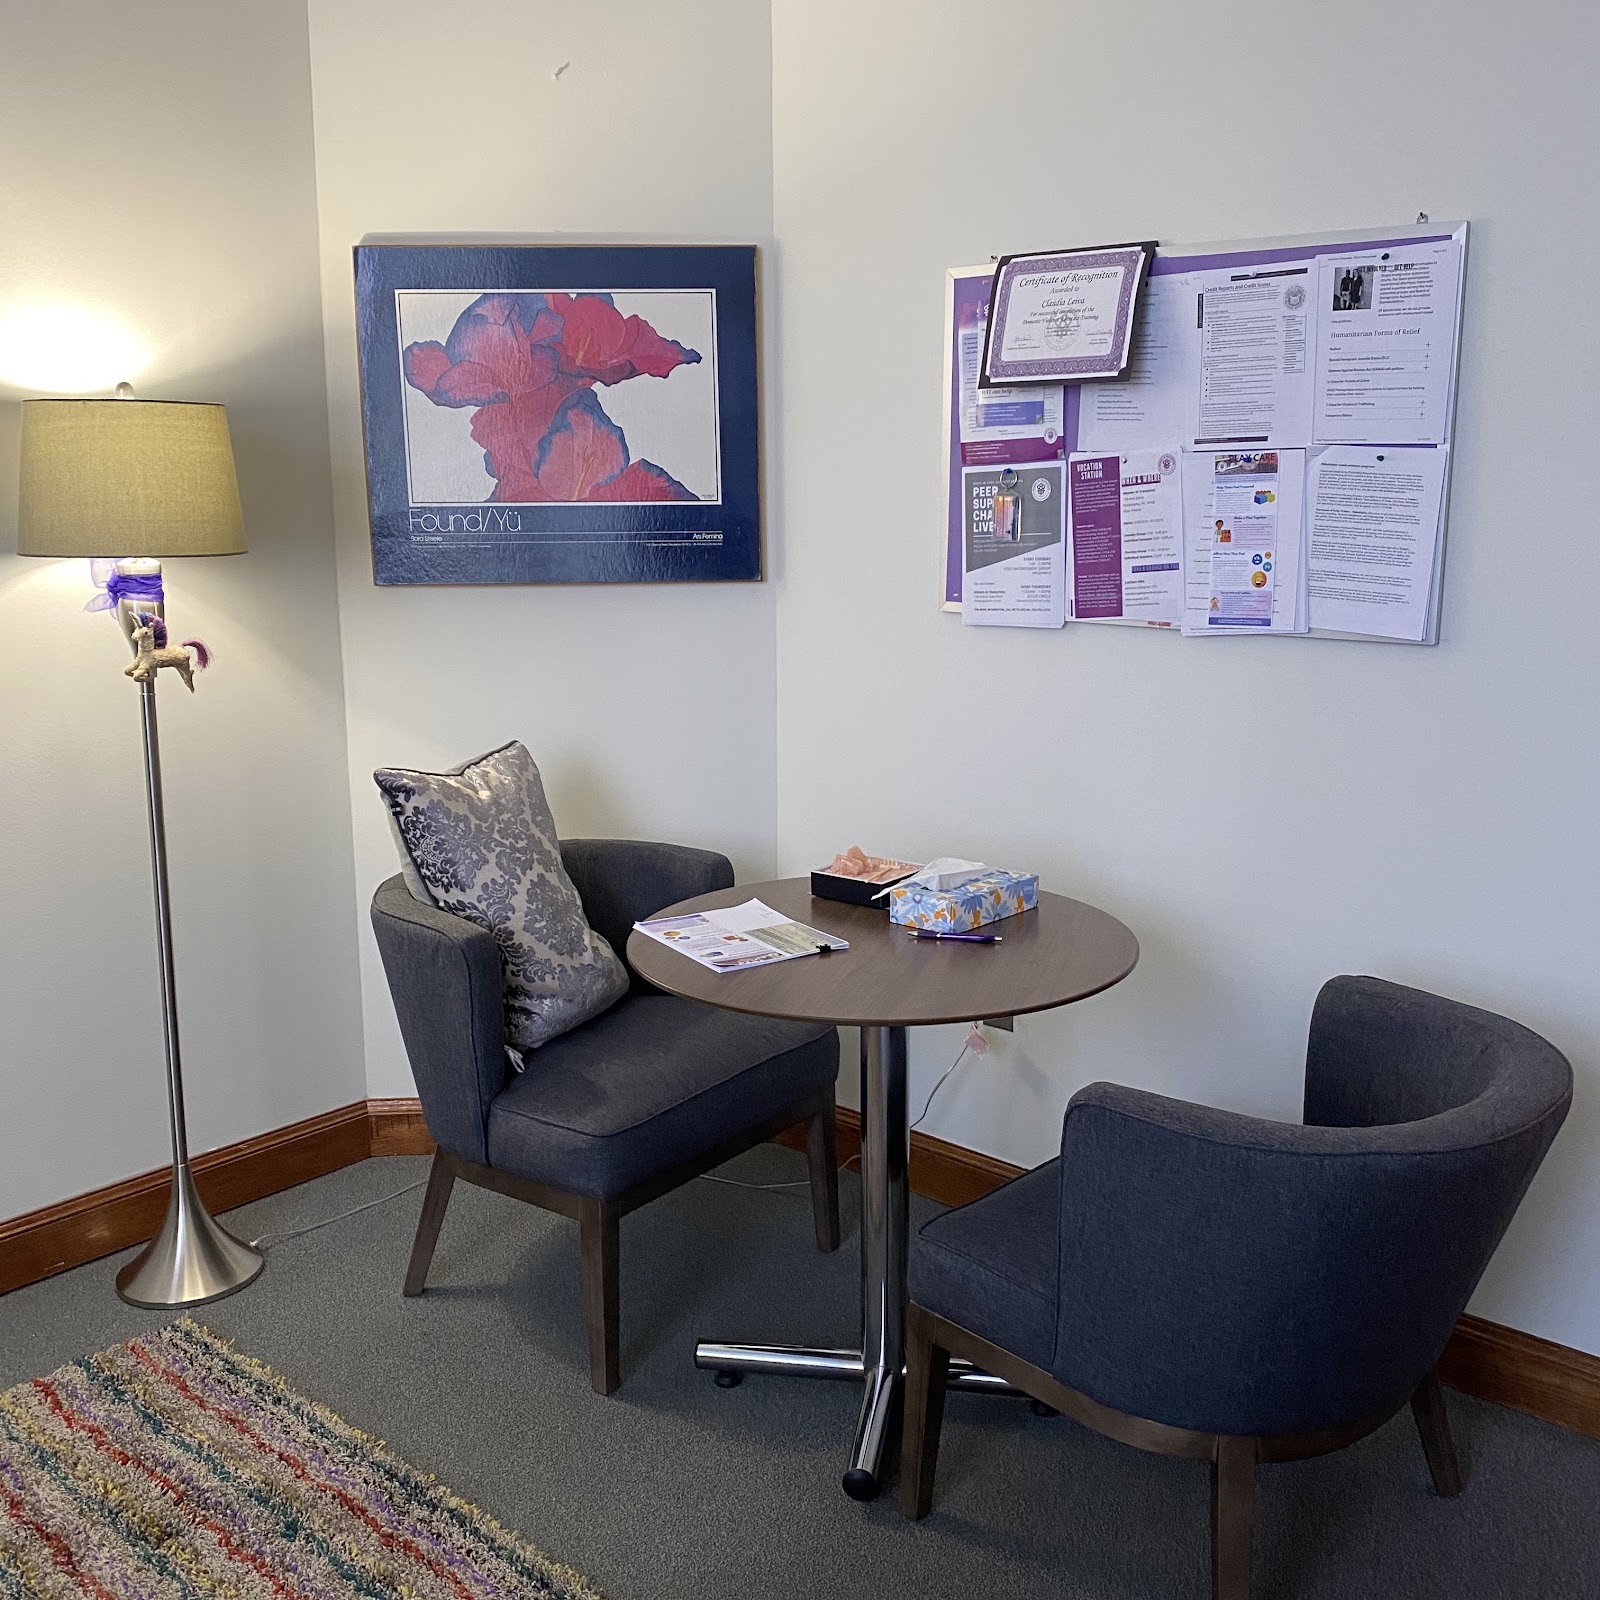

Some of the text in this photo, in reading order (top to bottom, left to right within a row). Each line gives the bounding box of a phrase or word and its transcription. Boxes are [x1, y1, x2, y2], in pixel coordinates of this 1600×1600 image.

[1019, 270, 1119, 288] Certificate of Recognition
[1050, 286, 1073, 294] Awarded
[1041, 297, 1085, 308] Claudia Leiva
[1330, 331, 1373, 339] Humanitarian
[1253, 452, 1275, 462] CARE
[1077, 461, 1103, 472] VOCATION
[1081, 470, 1103, 480] STATION
[973, 486, 999, 498] PEER
[973, 498, 995, 509] SUP
[409, 508, 521, 532] Found/Yü
[973, 510, 993, 521] CHA
[973, 521, 994, 533] LIVE
